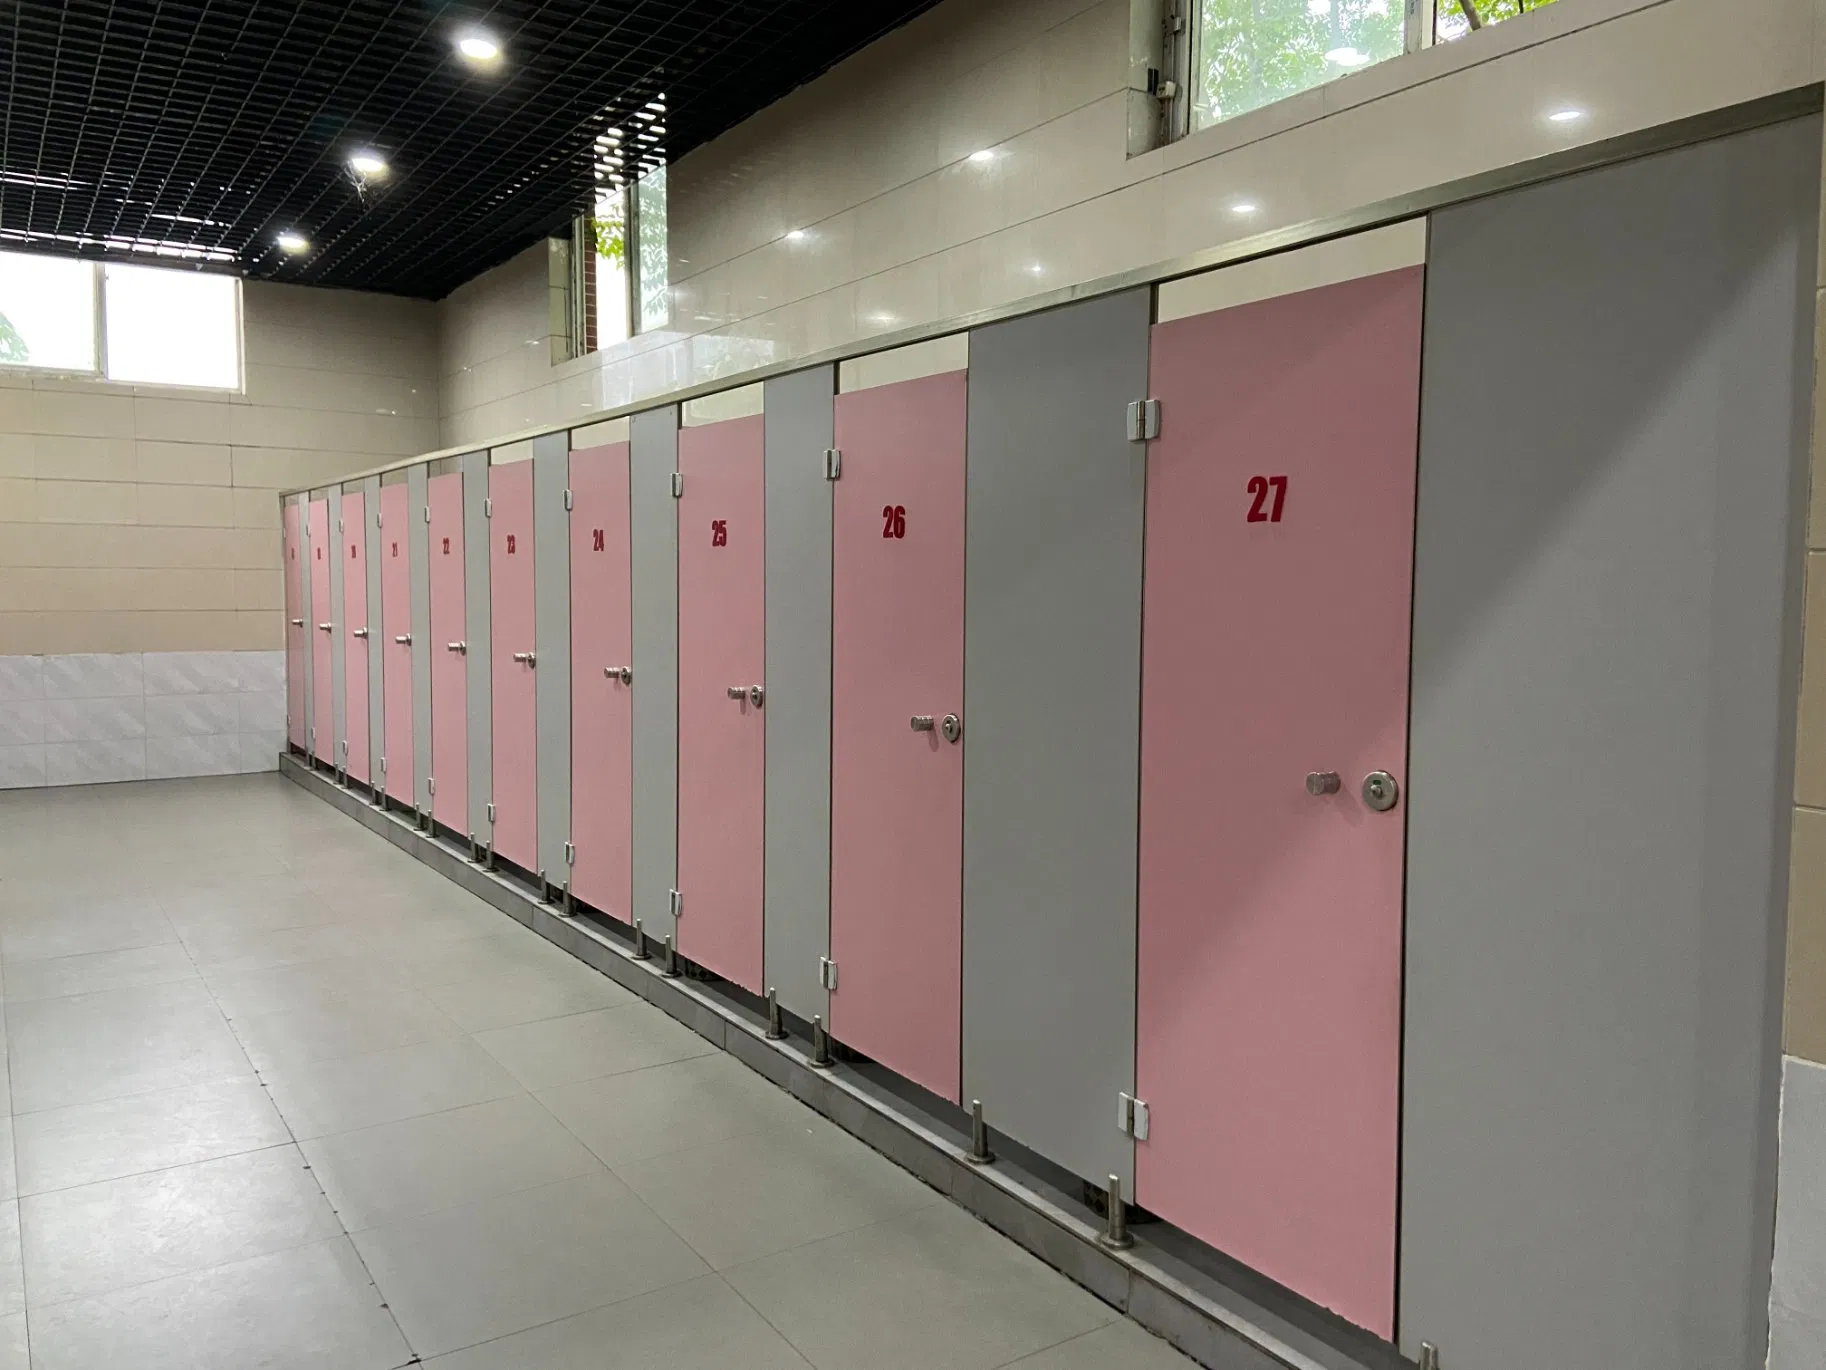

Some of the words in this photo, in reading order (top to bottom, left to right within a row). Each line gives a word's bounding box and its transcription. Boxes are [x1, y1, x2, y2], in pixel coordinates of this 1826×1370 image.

[1247, 475, 1288, 523] 27
[712, 520, 727, 547] 25
[882, 505, 906, 539] 26
[392, 542, 398, 558] 21
[443, 537, 450, 555] 22
[507, 534, 516, 554] 23
[593, 528, 605, 552] 24
